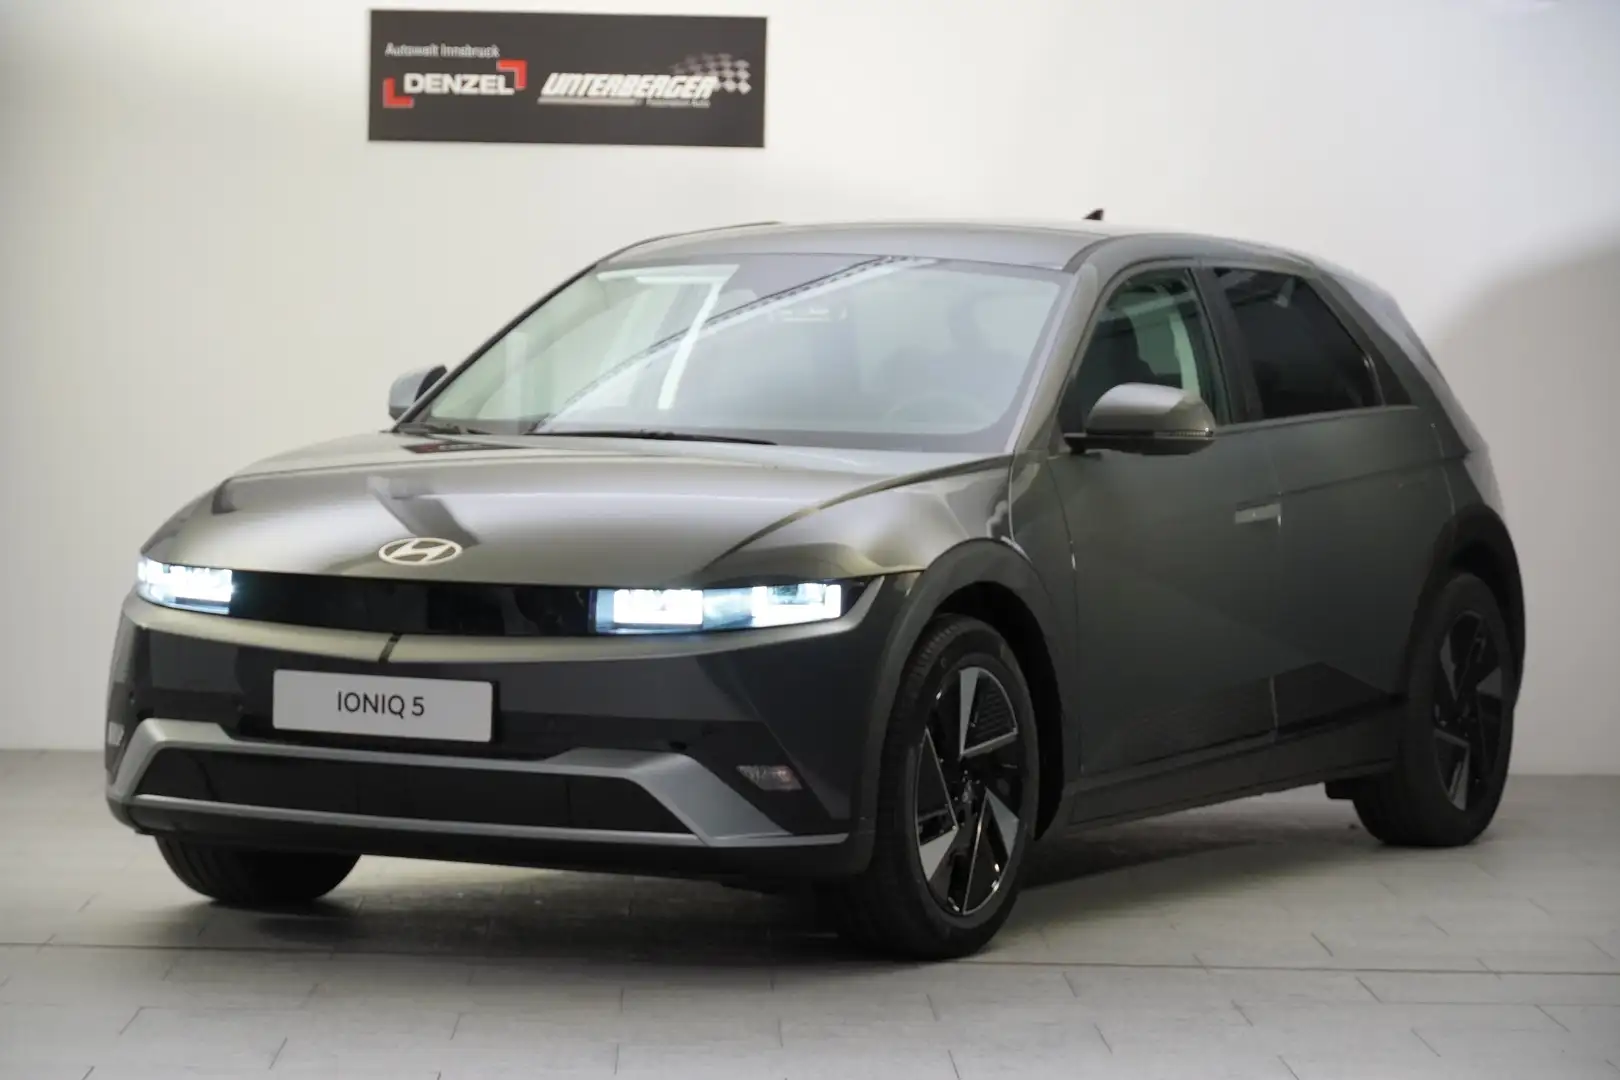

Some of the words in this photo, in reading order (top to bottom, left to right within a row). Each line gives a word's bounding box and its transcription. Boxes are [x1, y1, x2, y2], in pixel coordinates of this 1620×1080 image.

[385, 42, 439, 57] Autowelt
[440, 43, 500, 59] Innsbruck
[403, 72, 515, 96] DENZEL
[541, 73, 719, 100] UNTERBERGER
[337, 690, 405, 719] IONIQ
[411, 696, 425, 717] 5
